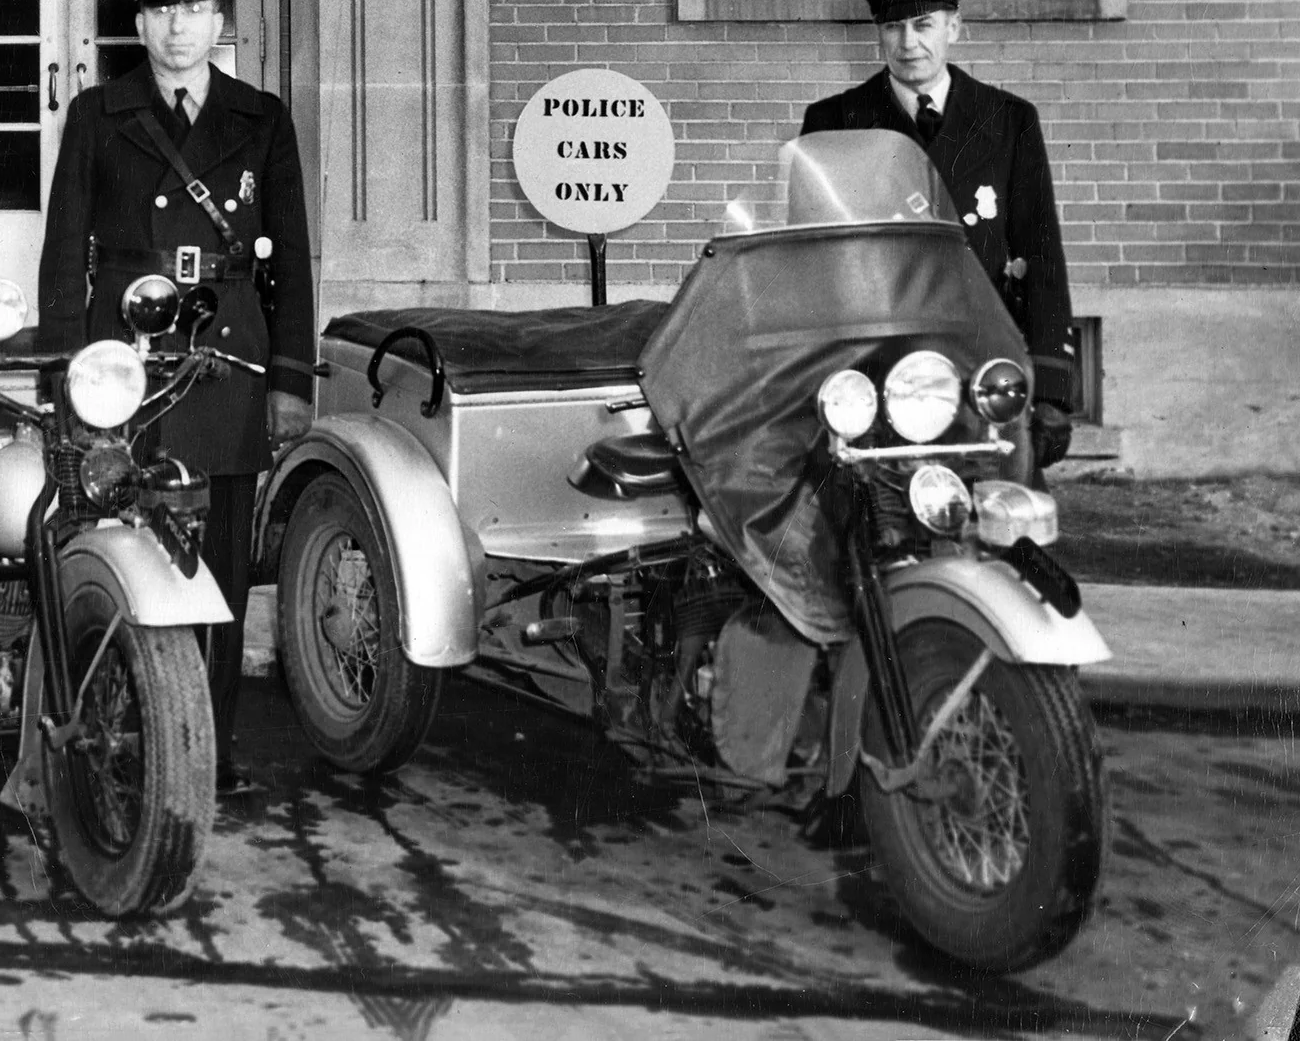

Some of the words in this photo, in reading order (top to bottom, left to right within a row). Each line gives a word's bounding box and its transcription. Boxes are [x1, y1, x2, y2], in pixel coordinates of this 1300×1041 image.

[543, 98, 645, 117] POLICE
[557, 141, 628, 159] CARS
[555, 183, 629, 202] ONLY
